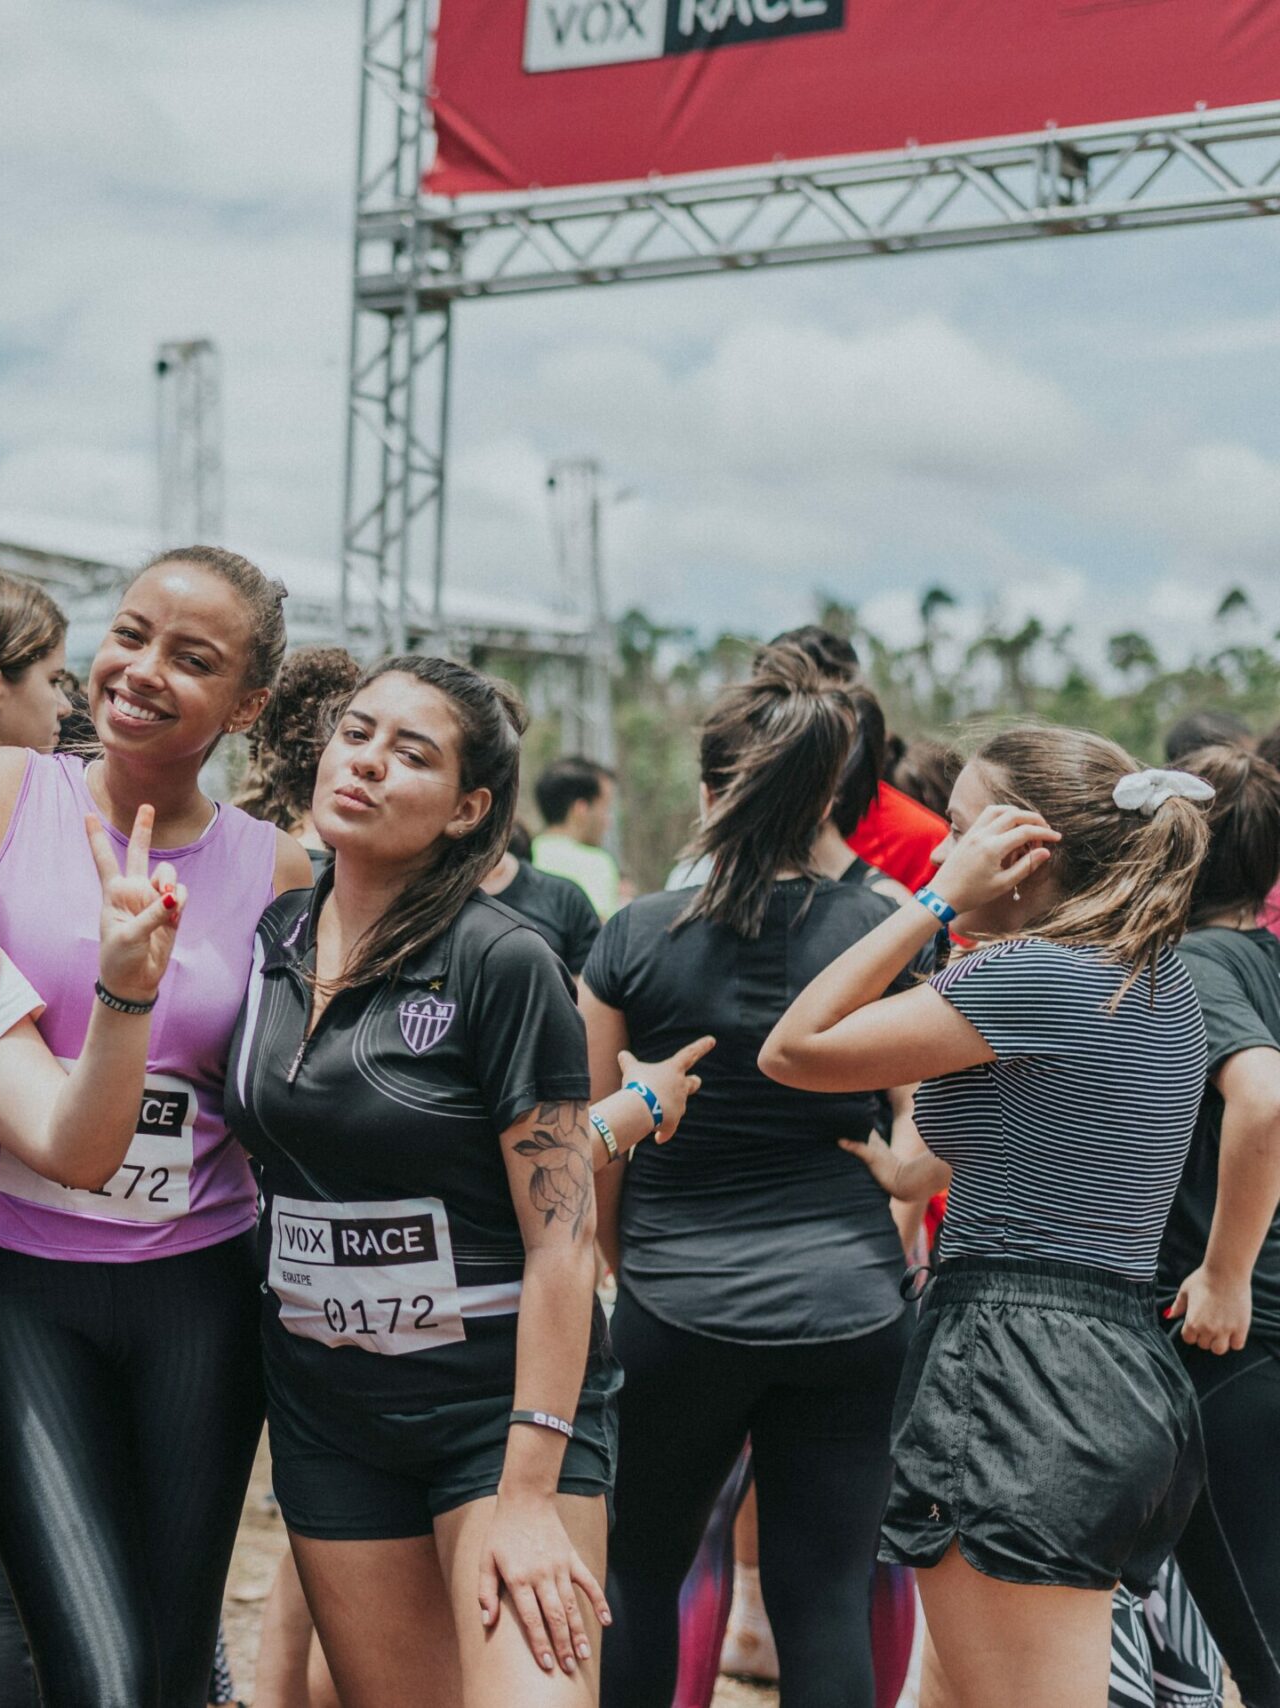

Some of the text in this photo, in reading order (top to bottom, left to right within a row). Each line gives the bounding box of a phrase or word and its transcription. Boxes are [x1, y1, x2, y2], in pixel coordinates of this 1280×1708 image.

[546, 0, 645, 46] VOX
[408, 1003, 449, 1017] CAM
[138, 1099, 180, 1126] CE
[284, 1224, 425, 1257] VOX RACE
[282, 1271, 312, 1286] EQUIPE
[323, 1294, 439, 1335] 0172
